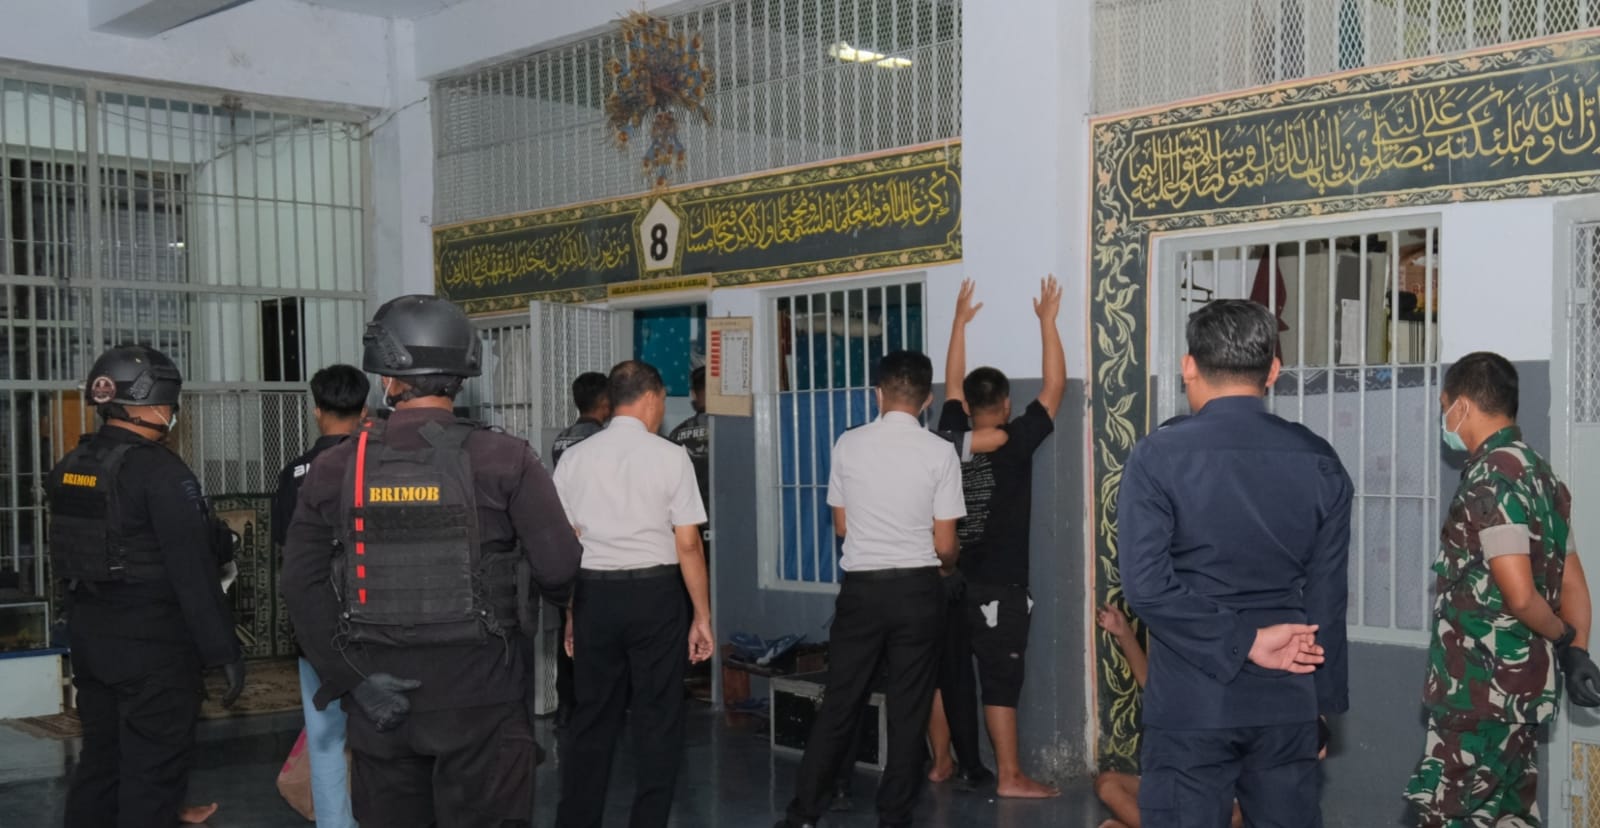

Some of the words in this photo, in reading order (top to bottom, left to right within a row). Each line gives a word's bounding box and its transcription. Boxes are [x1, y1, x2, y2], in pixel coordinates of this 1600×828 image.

[650, 223, 669, 262] 8
[63, 471, 97, 487] BRIMOB
[369, 486, 441, 509] BRIMOB
